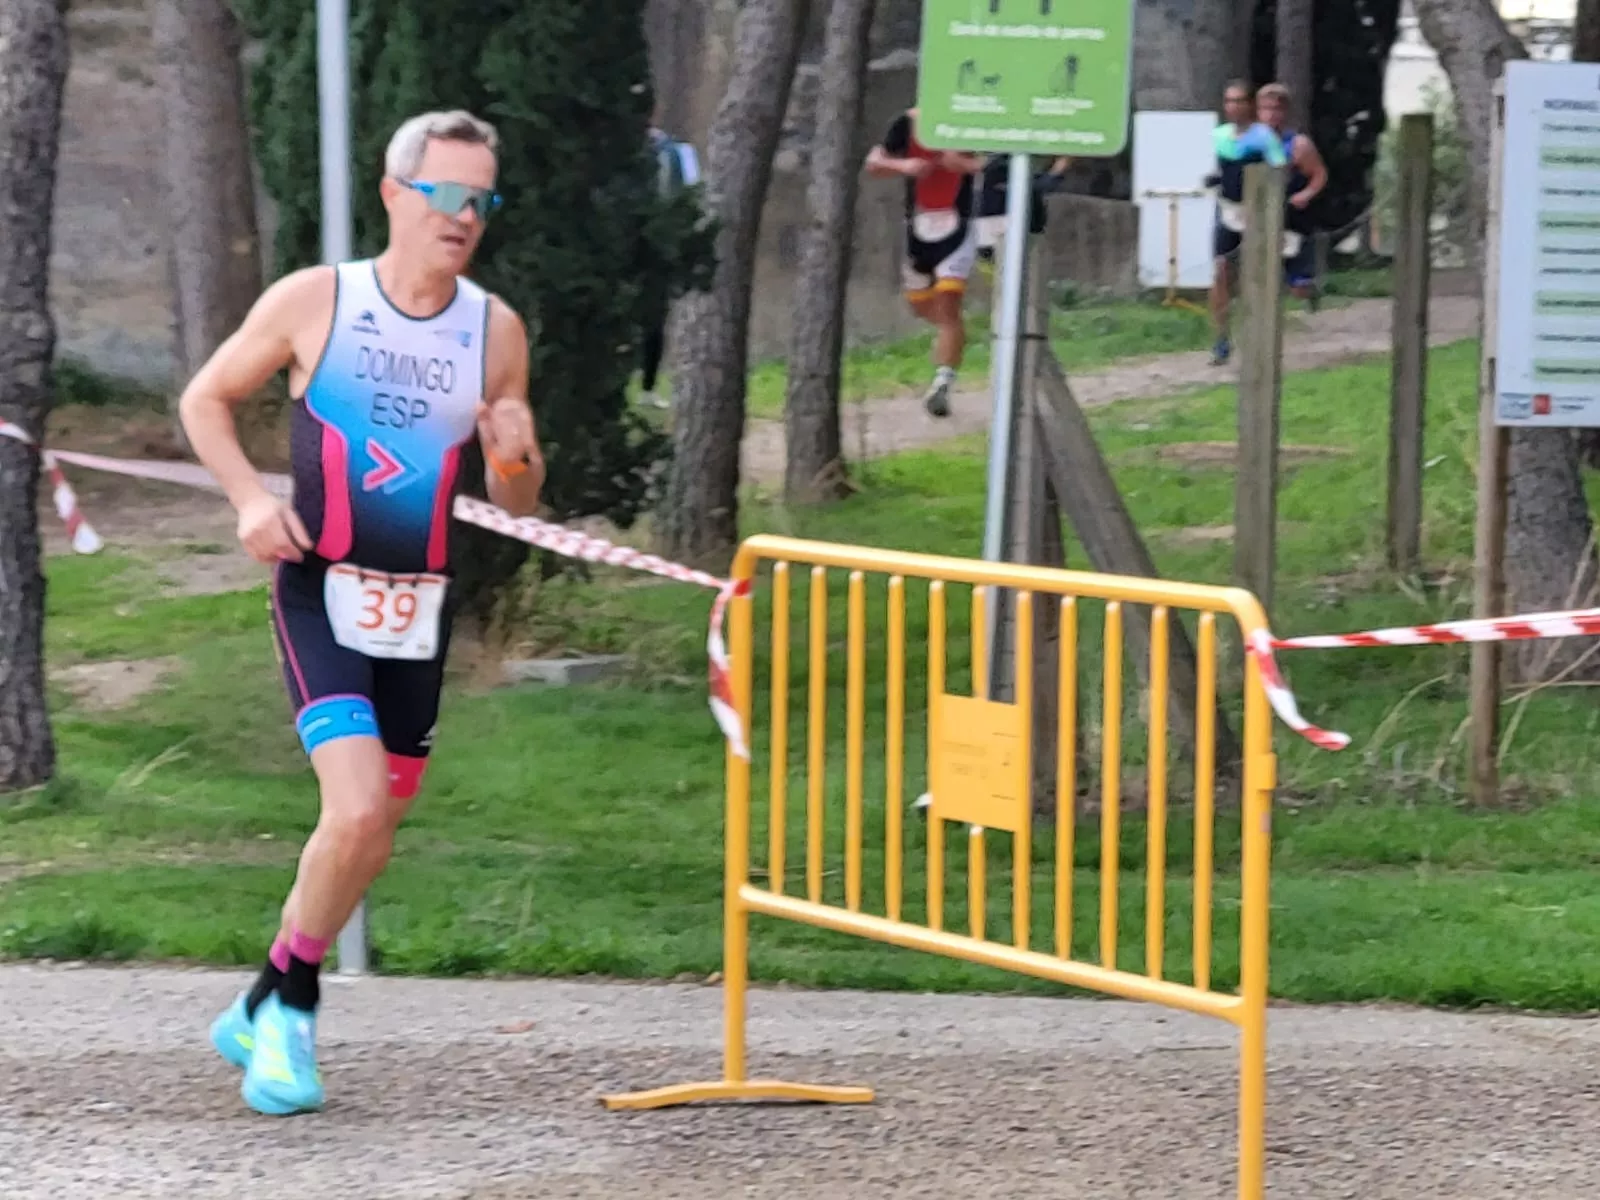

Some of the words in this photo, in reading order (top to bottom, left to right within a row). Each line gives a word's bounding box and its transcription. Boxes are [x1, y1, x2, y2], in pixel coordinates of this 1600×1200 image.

[355, 345, 455, 394] DOMINGO
[370, 392, 430, 429] ESP
[356, 589, 416, 633] 39
